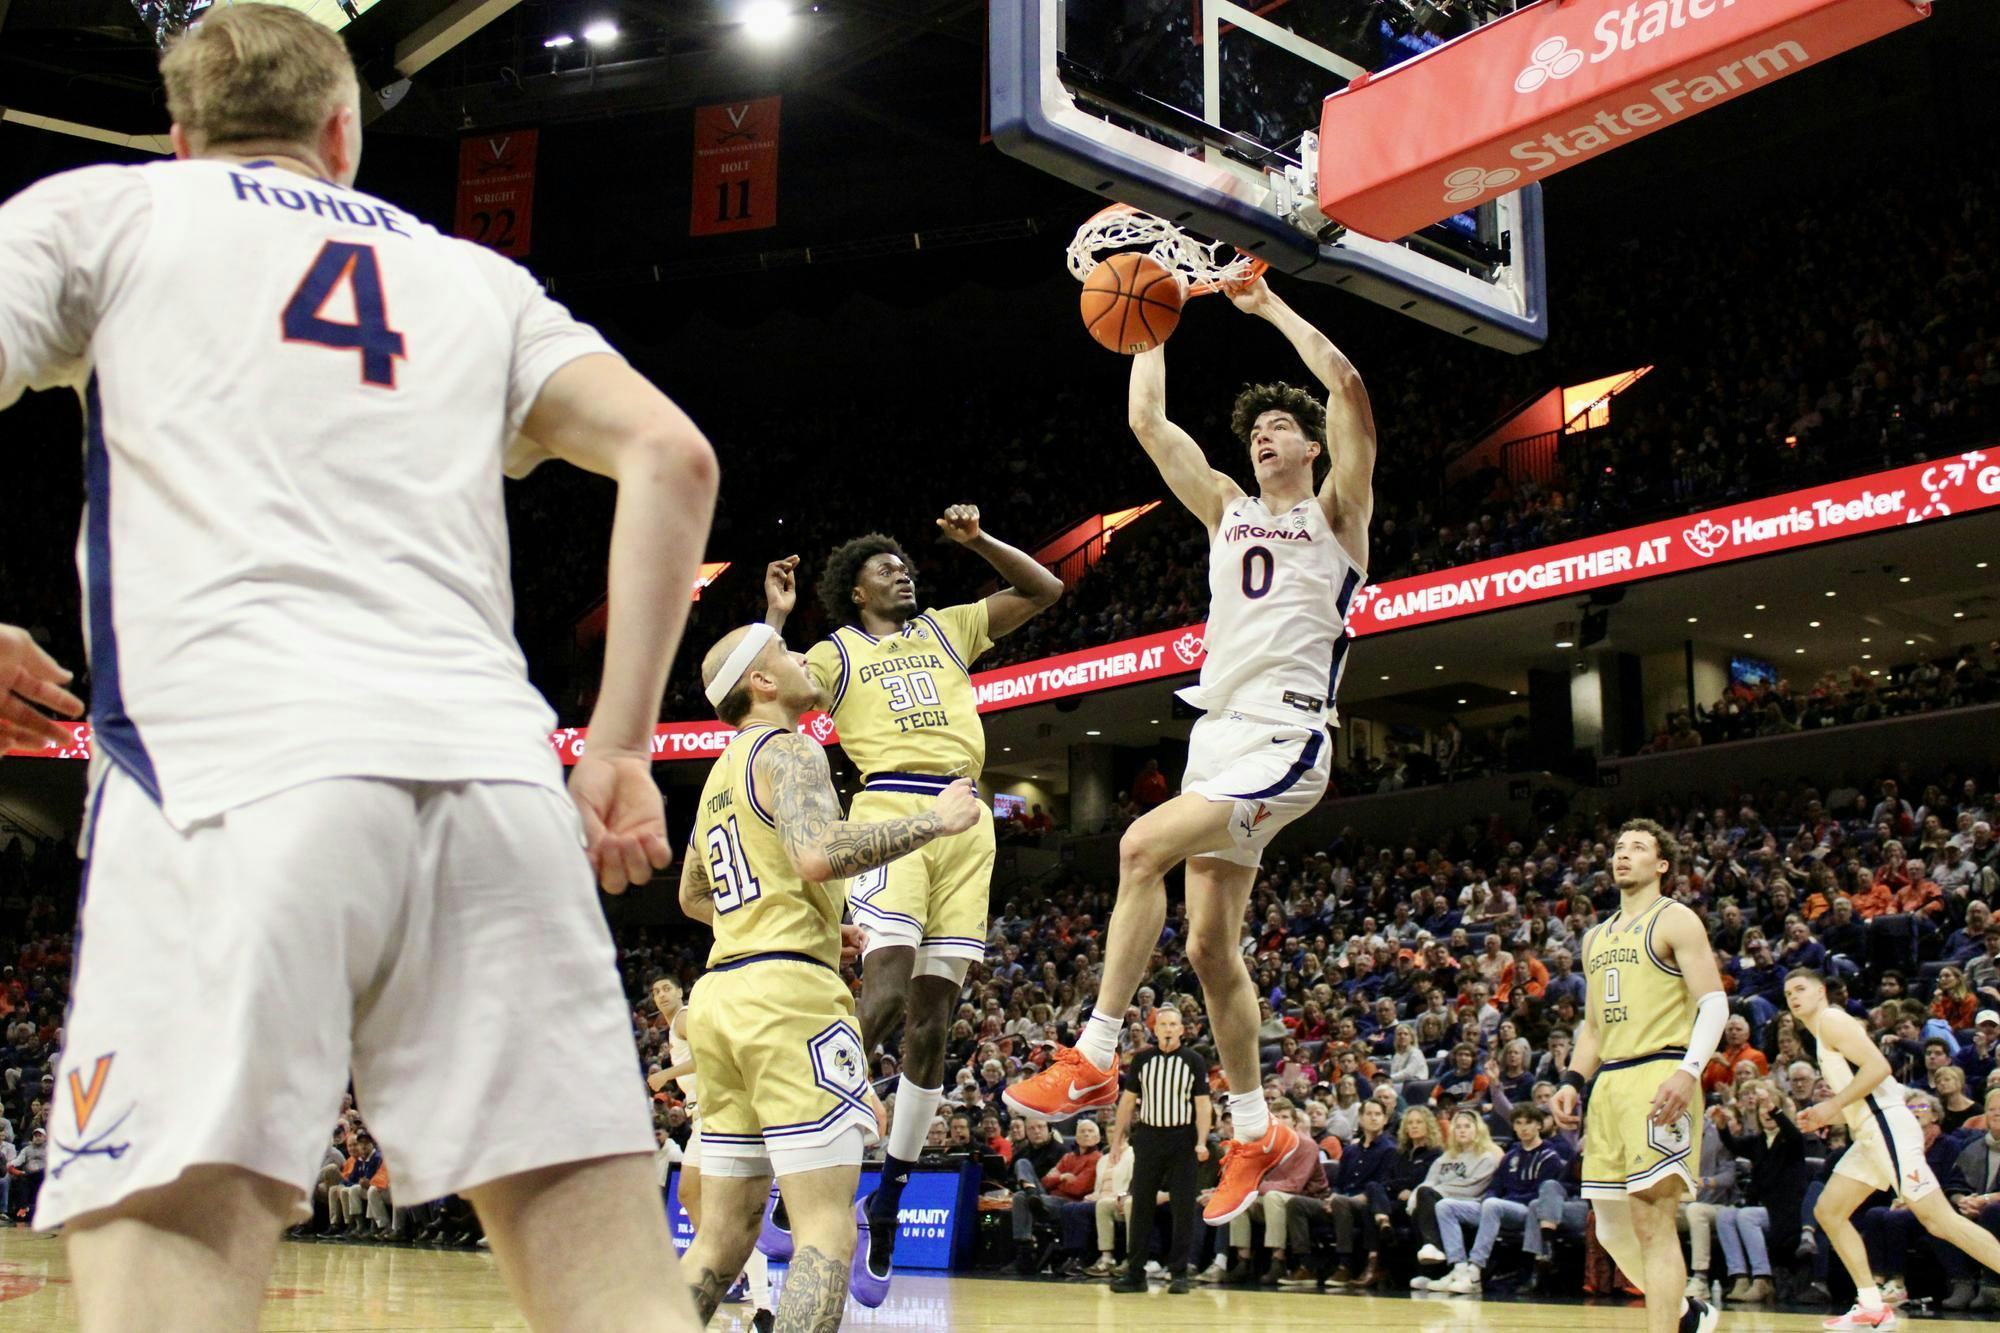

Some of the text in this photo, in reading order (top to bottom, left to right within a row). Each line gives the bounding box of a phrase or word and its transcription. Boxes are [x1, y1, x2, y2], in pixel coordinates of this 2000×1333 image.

[1590, 0, 1737, 64] State
[720, 160, 750, 173] HOLT
[228, 171, 413, 239] ROHDE
[473, 190, 517, 205] WRIGHT
[715, 178, 751, 223] 11
[280, 238, 408, 390] 4
[1224, 524, 1313, 544] VIRGINIA
[1732, 489, 1905, 545] Harris Teeter
[1242, 545, 1274, 599] 0
[1373, 536, 1671, 620] GAMEDAY TOGETHER AT
[859, 655, 944, 684] GEORGIA
[1040, 654, 1138, 691] TOGETHER
[1139, 646, 1165, 671] AT
[880, 671, 941, 712] 30
[895, 711, 949, 732] TECH
[707, 813, 761, 916] 31
[1590, 948, 1639, 974] GEORGIA
[1605, 967, 1620, 1003] 0
[903, 1227, 945, 1238] UNION
